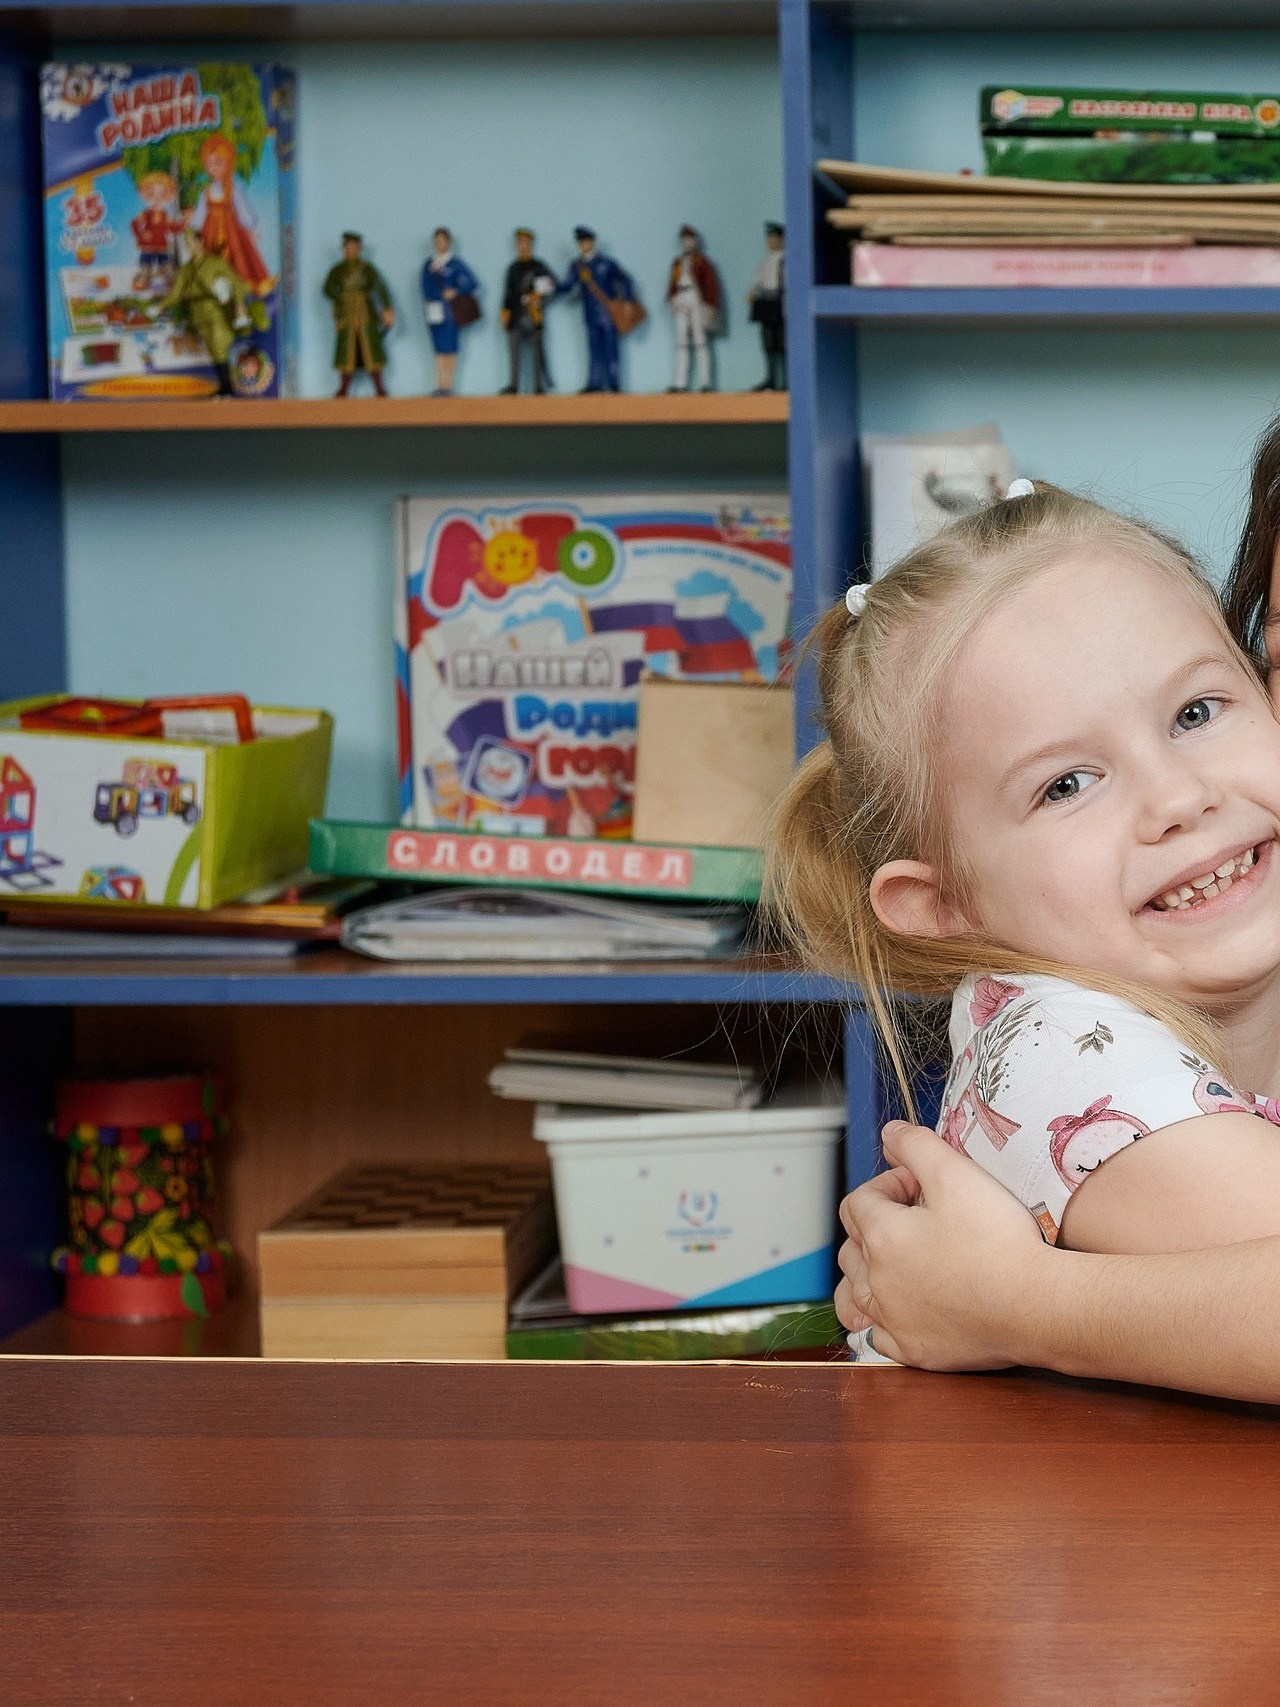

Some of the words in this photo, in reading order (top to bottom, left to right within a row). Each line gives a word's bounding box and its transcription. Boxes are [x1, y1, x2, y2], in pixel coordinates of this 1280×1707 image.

[111, 72, 198, 115] НАША
[101, 99, 217, 151] РОДИНА
[63, 195, 105, 226] 35
[392, 836, 685, 880] СЛОВОДЕЛ
